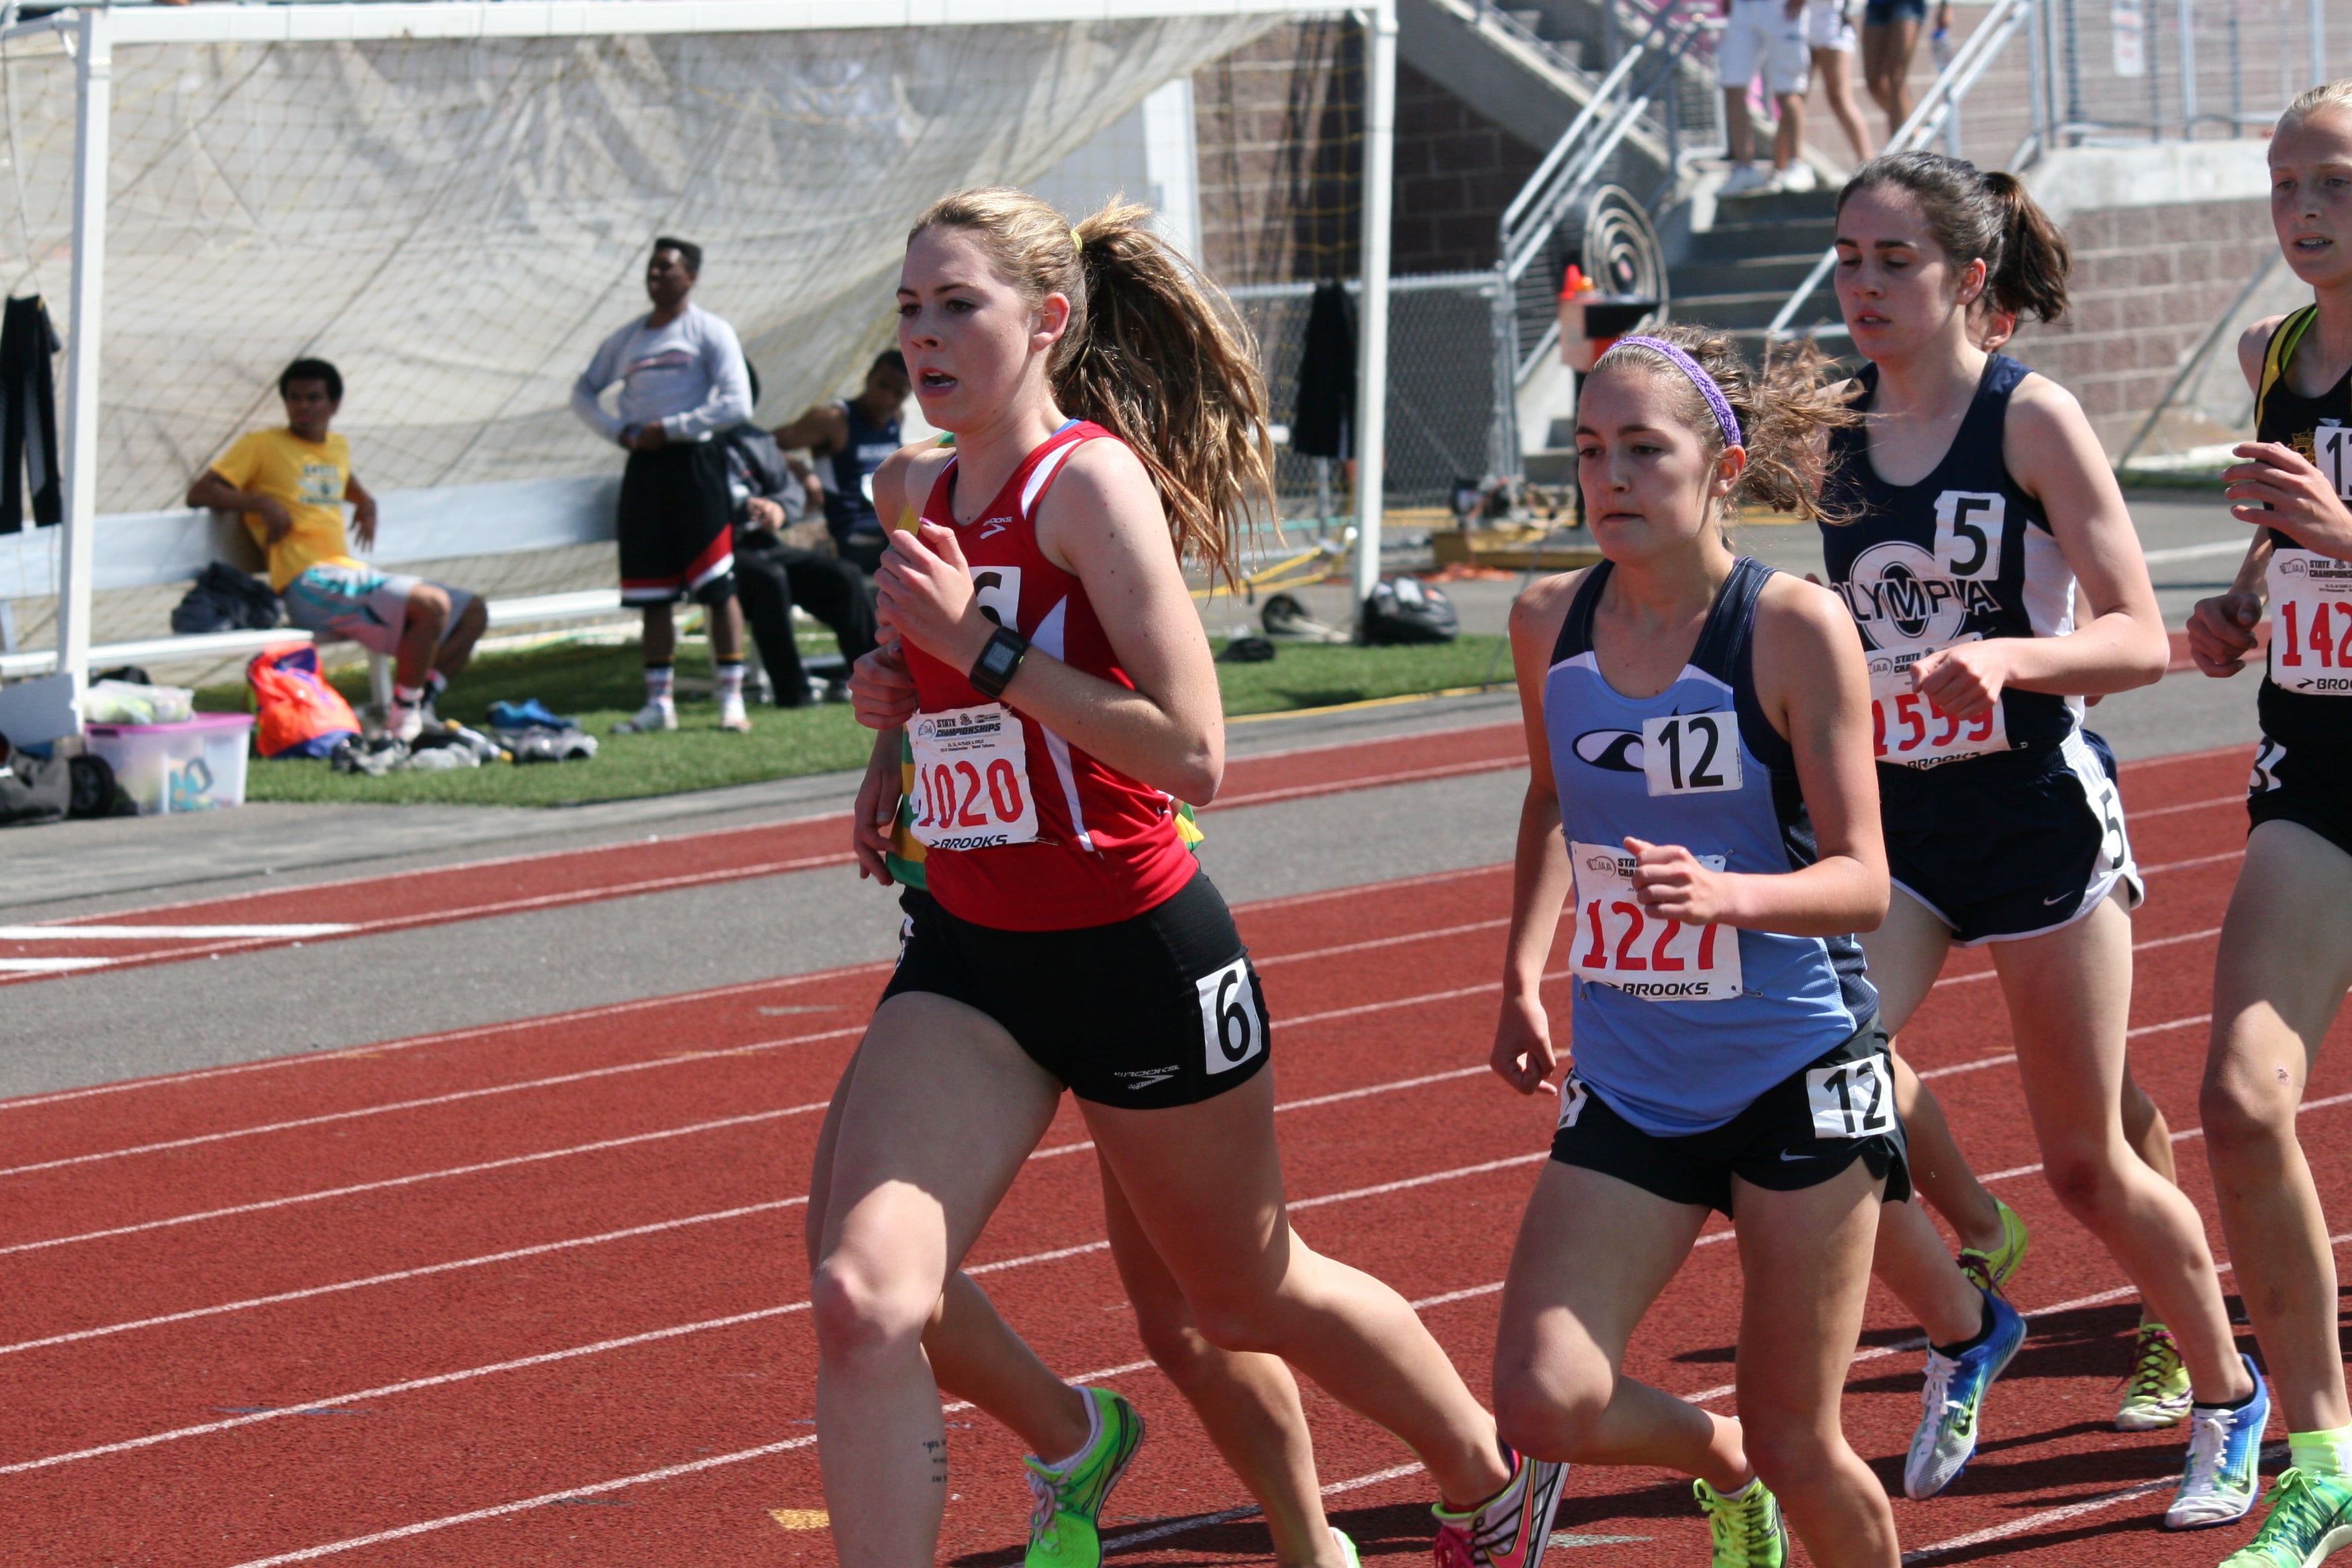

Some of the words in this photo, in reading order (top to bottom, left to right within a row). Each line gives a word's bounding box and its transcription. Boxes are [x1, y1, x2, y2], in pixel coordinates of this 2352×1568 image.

[983, 516, 1013, 526] BROOKS
[1950, 497, 1991, 576] 5
[2310, 560, 2331, 569] STATE
[1895, 652, 1921, 664] STATE
[2317, 679, 2352, 689] BRO
[935, 722, 1001, 737] CHAMPIONSHIPS
[936, 718, 957, 728] STATE
[1658, 716, 1724, 789] 12
[1908, 751, 1981, 769] BROOKS
[918, 758, 1024, 828] 1020
[2099, 788, 2125, 869] 5
[940, 835, 1008, 849] BROOKS
[1618, 859, 1638, 867] STA
[1582, 899, 1717, 971] 1227
[1623, 982, 1710, 995] BROOKS
[1216, 969, 1251, 1062] 6
[1823, 1061, 1886, 1133] 12
